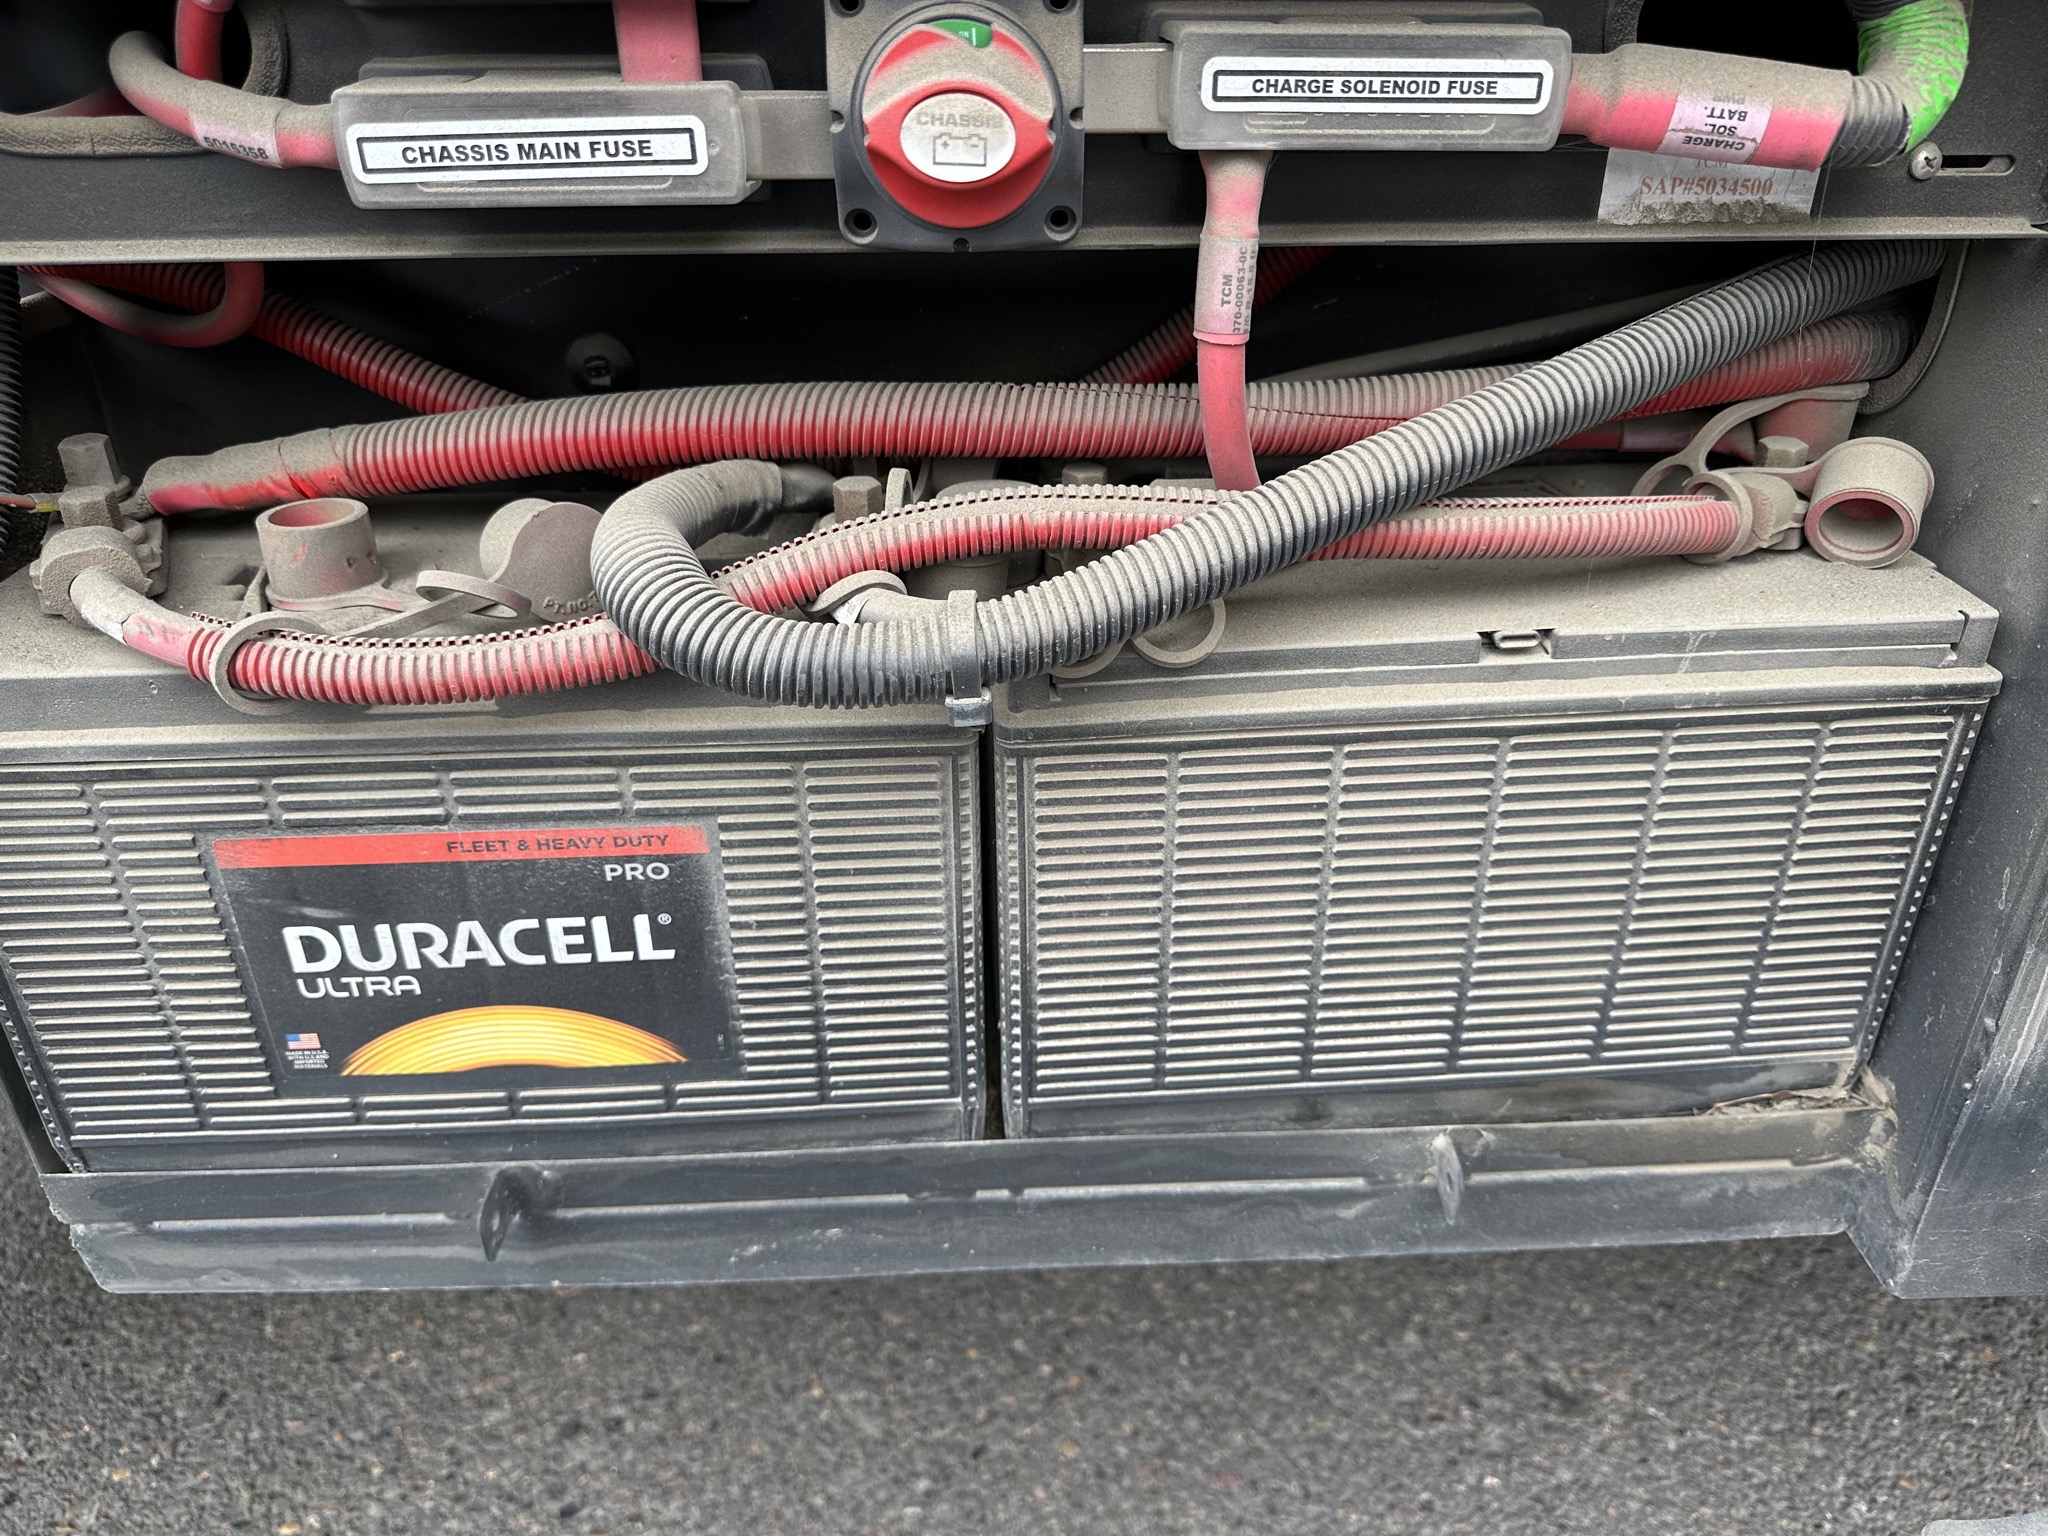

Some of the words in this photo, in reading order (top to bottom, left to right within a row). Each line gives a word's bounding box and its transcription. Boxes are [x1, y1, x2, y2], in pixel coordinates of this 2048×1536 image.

[1251, 78, 1334, 94] CHARGE
[1340, 79, 1440, 95] SOLENOID
[1446, 80, 1498, 95] FUSE
[916, 112, 1005, 128] CHASSIS
[1704, 106, 1748, 122] BATT.
[1704, 123, 1738, 136] SOL.
[203, 136, 269, 160] 5015358
[401, 143, 510, 164] CHASSIS
[517, 141, 581, 162] MAIN
[589, 139, 653, 158] FUSE
[1682, 135, 1746, 151] CHARGE
[1640, 176, 1774, 196] SAP#5034500
[1221, 274, 1233, 307] TCM
[447, 840, 510, 853] FLEET
[517, 839, 531, 851] &
[536, 836, 606, 851] HEAVY
[613, 834, 669, 848] DUTY
[604, 862, 670, 882] PRO
[297, 975, 422, 999] ULTRA
